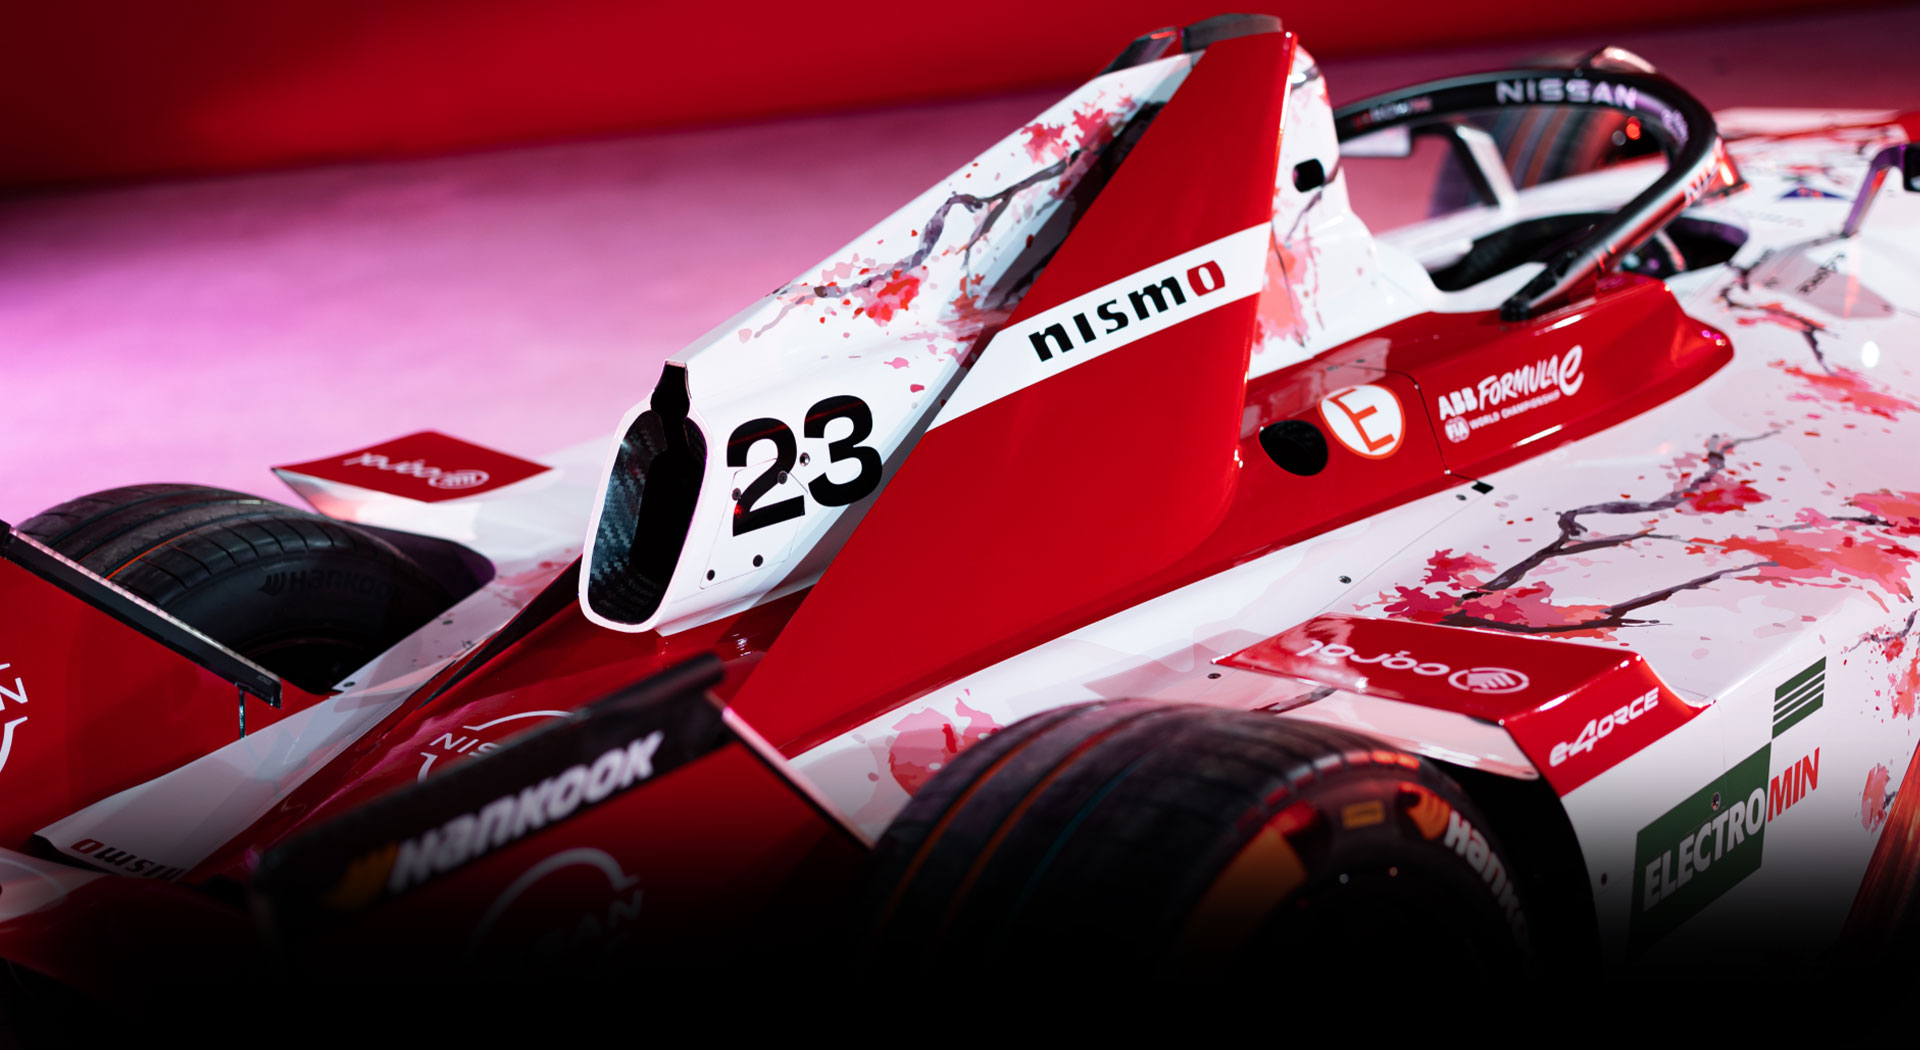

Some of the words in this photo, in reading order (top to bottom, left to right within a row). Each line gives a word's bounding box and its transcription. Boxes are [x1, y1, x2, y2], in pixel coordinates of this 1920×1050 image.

[1496, 78, 1636, 110] NISSAN
[1438, 387, 1478, 420] ABB
[1445, 417, 1470, 442] FIA
[1468, 411, 1500, 430] WORLD
[1501, 389, 1561, 419] CHAMPIONSHIP
[727, 395, 883, 537] 23
